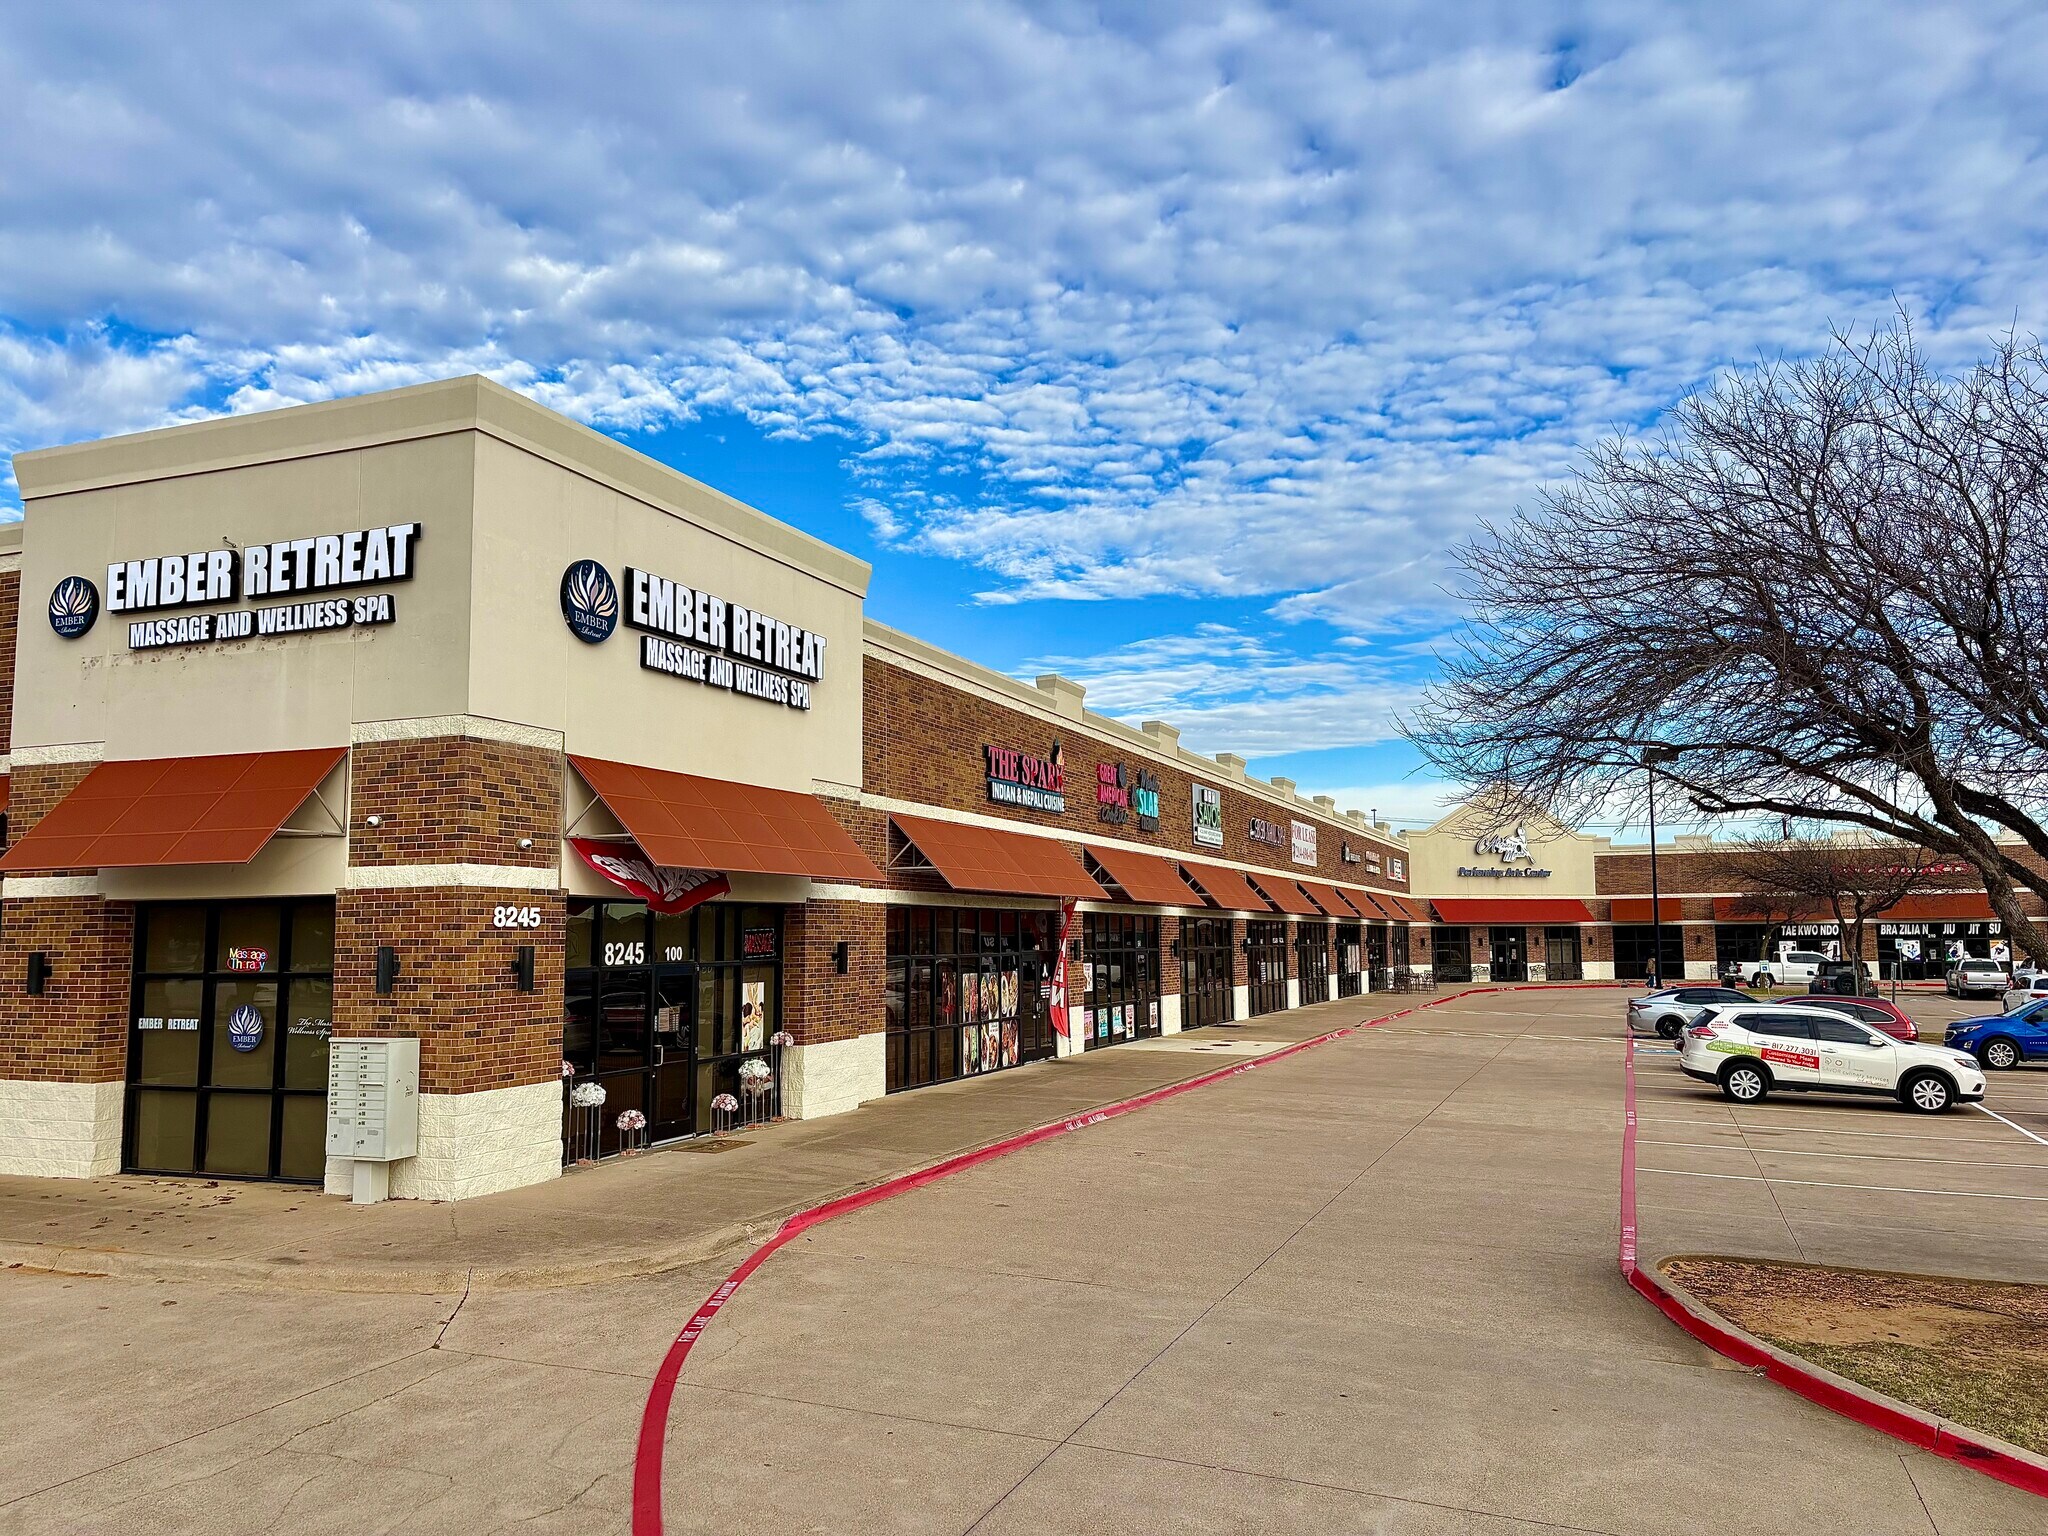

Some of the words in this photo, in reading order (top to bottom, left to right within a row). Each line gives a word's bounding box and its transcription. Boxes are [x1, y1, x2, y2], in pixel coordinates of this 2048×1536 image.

[106, 551, 236, 613] EMBER
[243, 523, 416, 597] RETREAT
[55, 614, 85, 627] EMBER
[129, 614, 210, 648] MASSAGE
[215, 612, 252, 640] AND
[258, 600, 348, 635] WELLNESS
[353, 594, 390, 624] SPA
[574, 610, 609, 631] EMBER
[633, 568, 727, 649] EMBER
[733, 604, 827, 681] RETREAT
[646, 637, 706, 681] MASSAGE
[709, 656, 733, 688] AND
[735, 663, 789, 704] WELLNESS
[790, 682, 811, 710] SPA
[988, 746, 1019, 783] THE
[1099, 763, 1118, 785] GREAT
[992, 782, 1015, 802] INDIAN
[1016, 787, 1022, 803] &
[1022, 788, 1043, 808] NEPALI
[1044, 793, 1065, 813] CUISINE
[1139, 788, 1159, 818] SLAB
[1458, 867, 1503, 878] Performing
[1504, 867, 1523, 877] Arts
[1524, 867, 1552, 877] Center
[493, 906, 541, 928] 8245
[1943, 923, 1956, 935] JIU
[229, 948, 266, 961] Massage
[604, 942, 644, 966] 8245
[665, 946, 683, 961] 100
[231, 958, 266, 971] Therapy
[138, 1017, 163, 1030] EMBER
[167, 1018, 199, 1031] RETREAT
[232, 1035, 257, 1043] EMBER
[1767, 1049, 1797, 1060] Customized
[1799, 1054, 1814, 1063] Meals
[1771, 1042, 1817, 1056] 817.277.3031
[1766, 1055, 1786, 1063] Delivered
